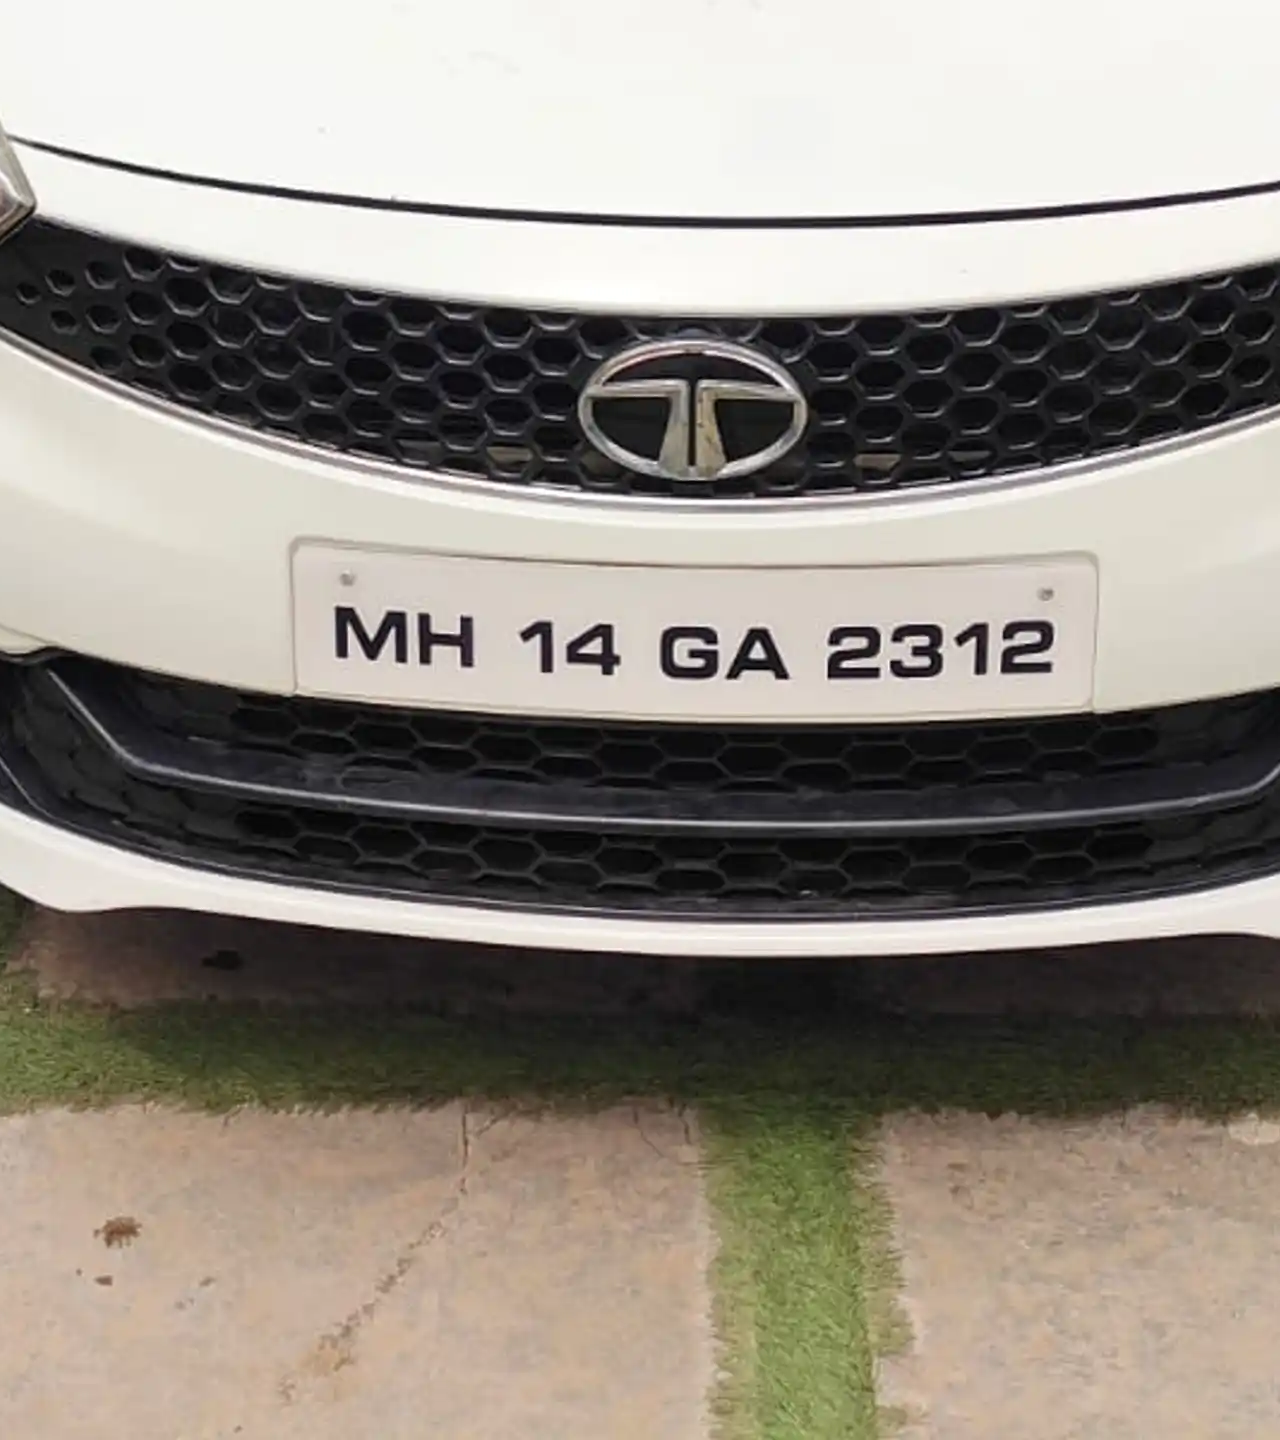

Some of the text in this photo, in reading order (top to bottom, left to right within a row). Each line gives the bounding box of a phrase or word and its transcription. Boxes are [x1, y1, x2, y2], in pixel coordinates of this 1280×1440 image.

[334, 605, 1055, 680] MH 14 GA 2312
